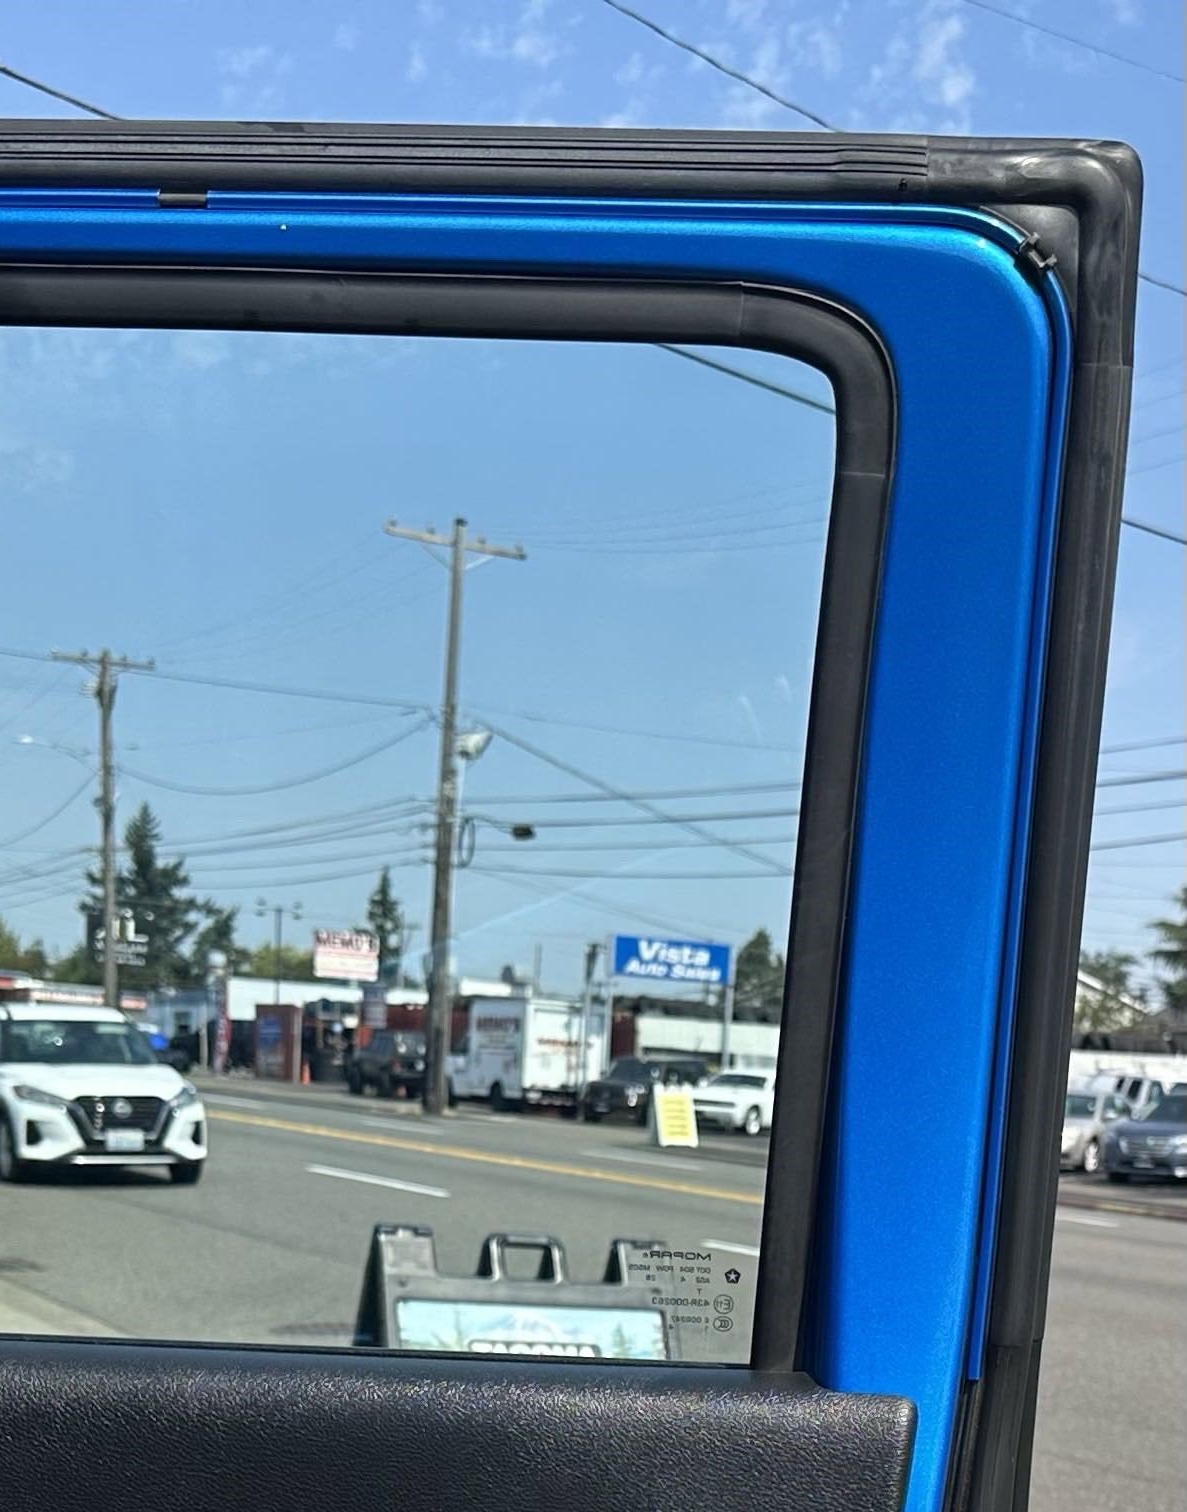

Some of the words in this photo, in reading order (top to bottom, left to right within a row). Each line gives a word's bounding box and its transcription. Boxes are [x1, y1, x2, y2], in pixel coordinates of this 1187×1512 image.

[638, 940, 710, 966] Vista
[625, 958, 668, 976] Auto
[670, 964, 721, 980] Sales
